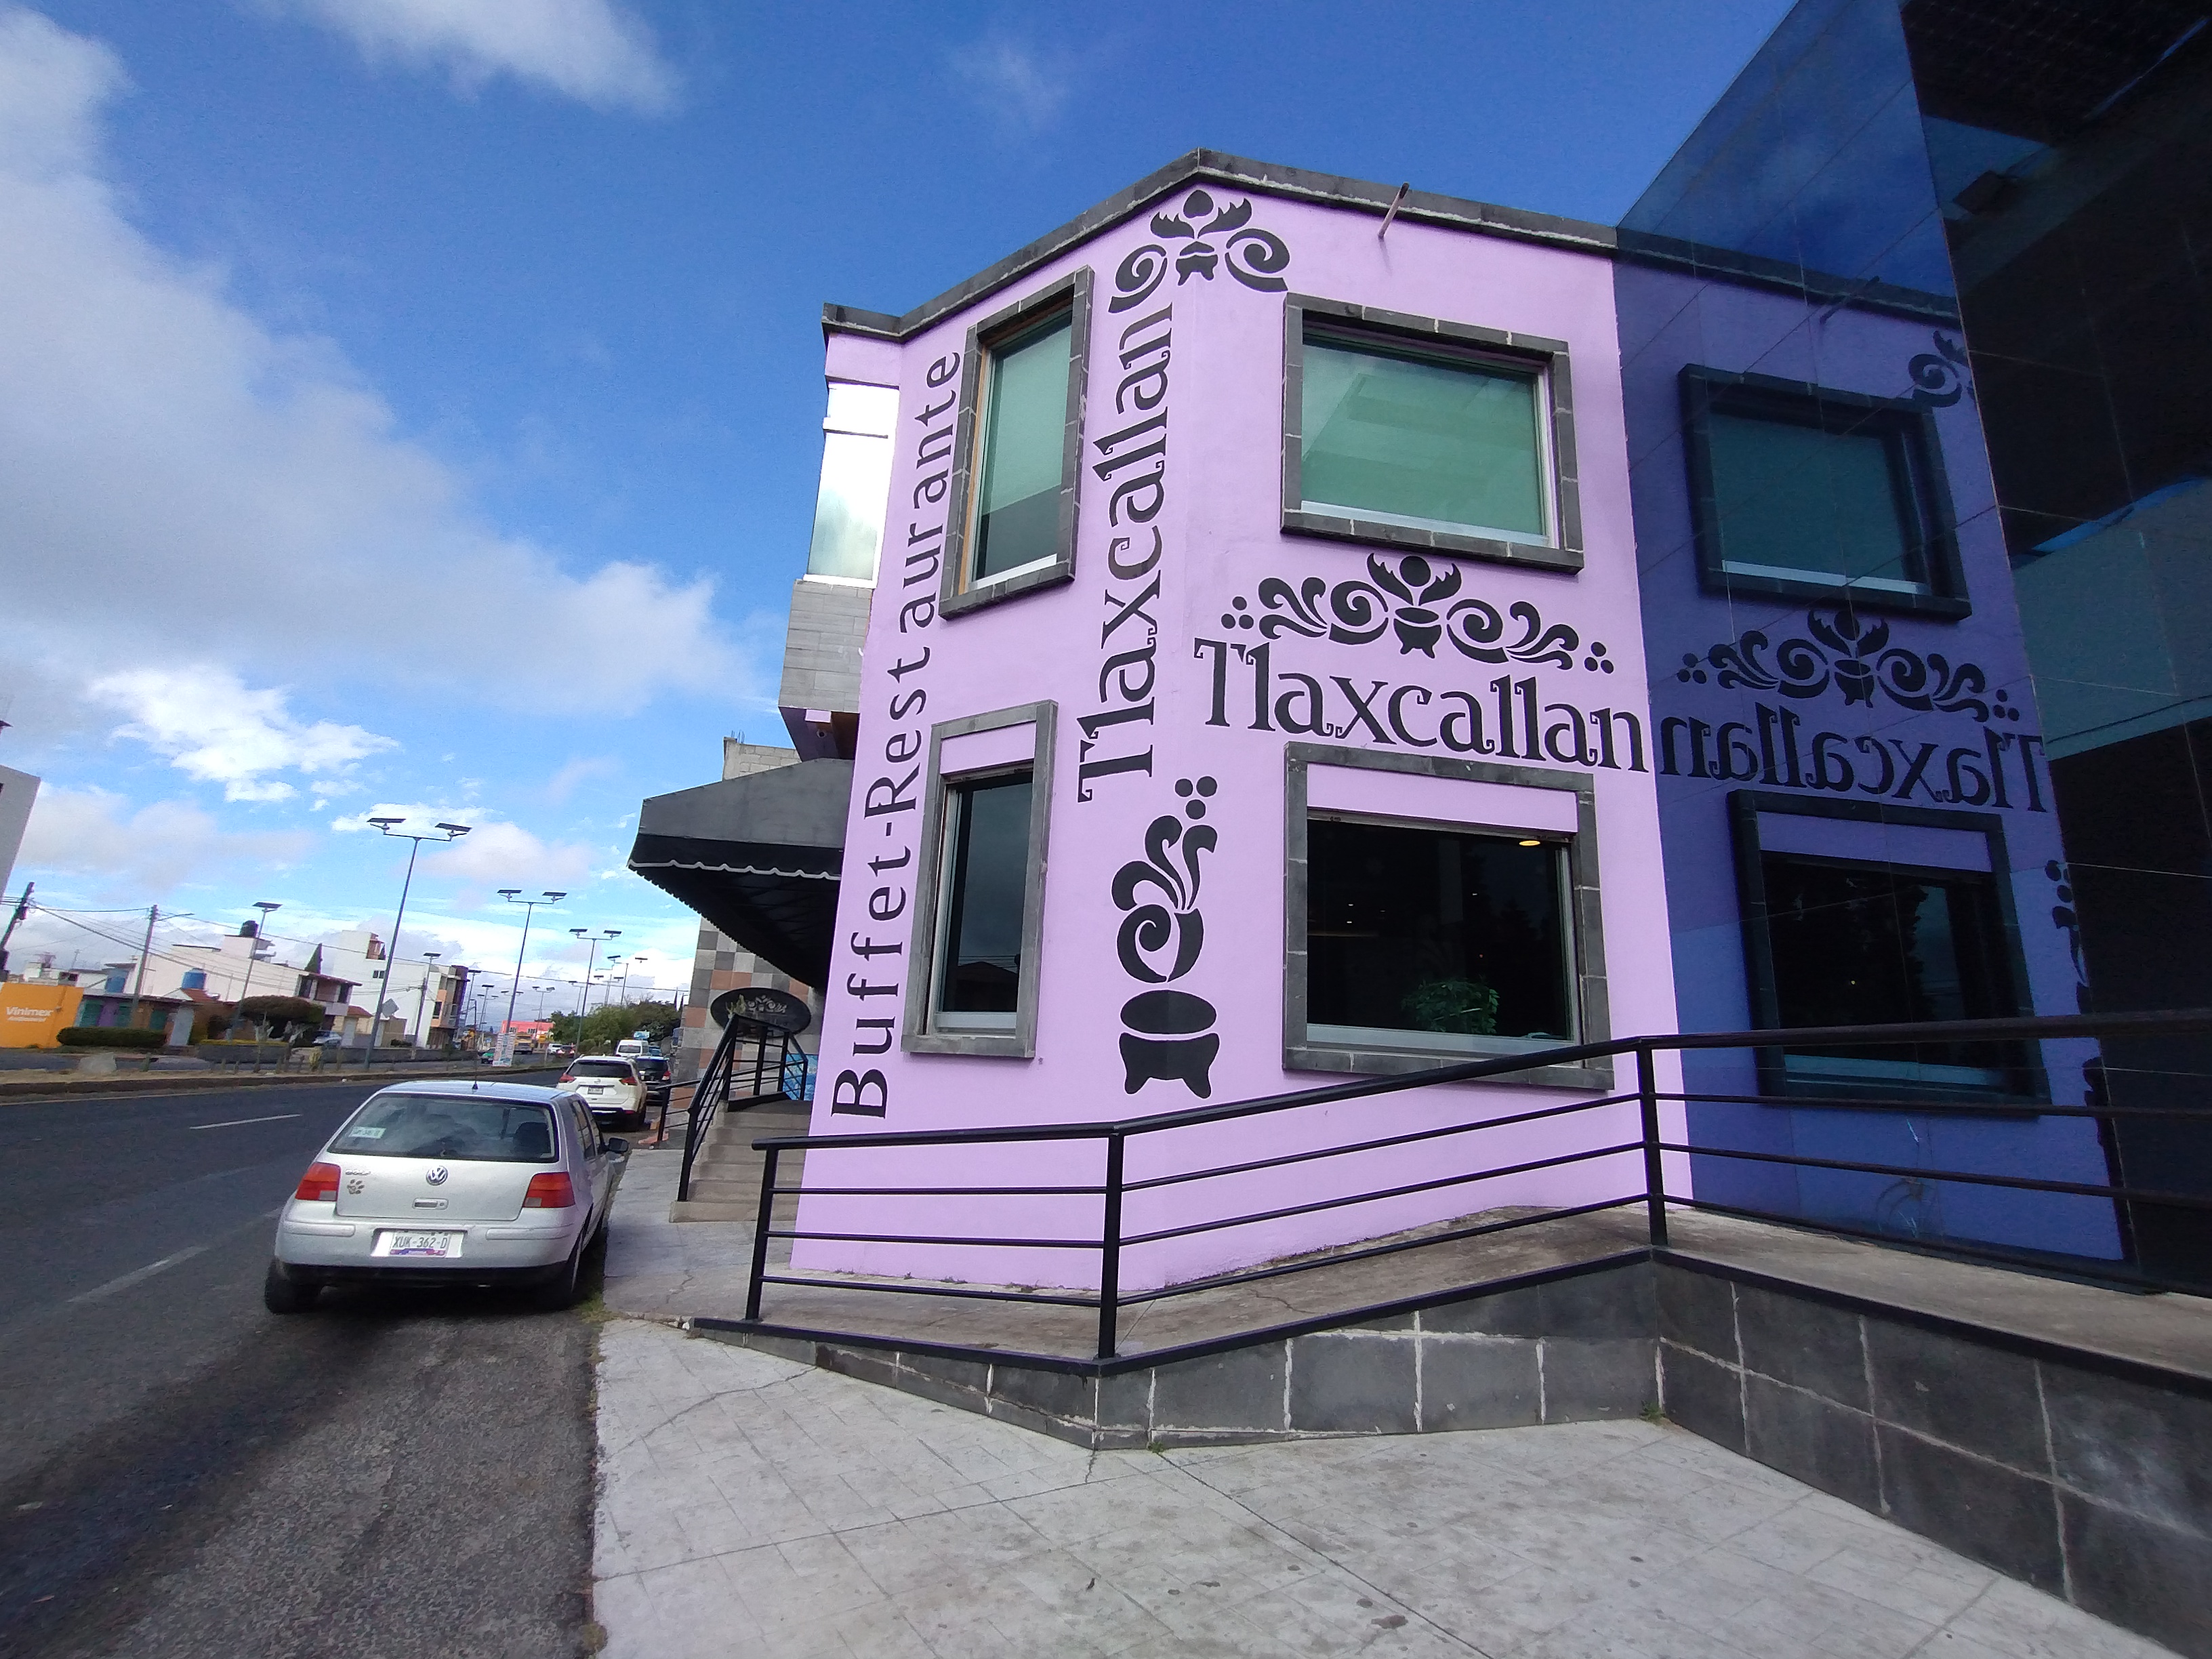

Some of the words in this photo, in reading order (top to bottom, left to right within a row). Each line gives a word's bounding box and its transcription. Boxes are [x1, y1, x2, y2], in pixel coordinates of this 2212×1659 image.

[1078, 302, 1173, 802] Tlaxcallan
[1194, 638, 1649, 773] Tlaxcallan
[831, 351, 960, 1120] Buffet-Restaurante
[6, 1006, 54, 1017] Vinimex
